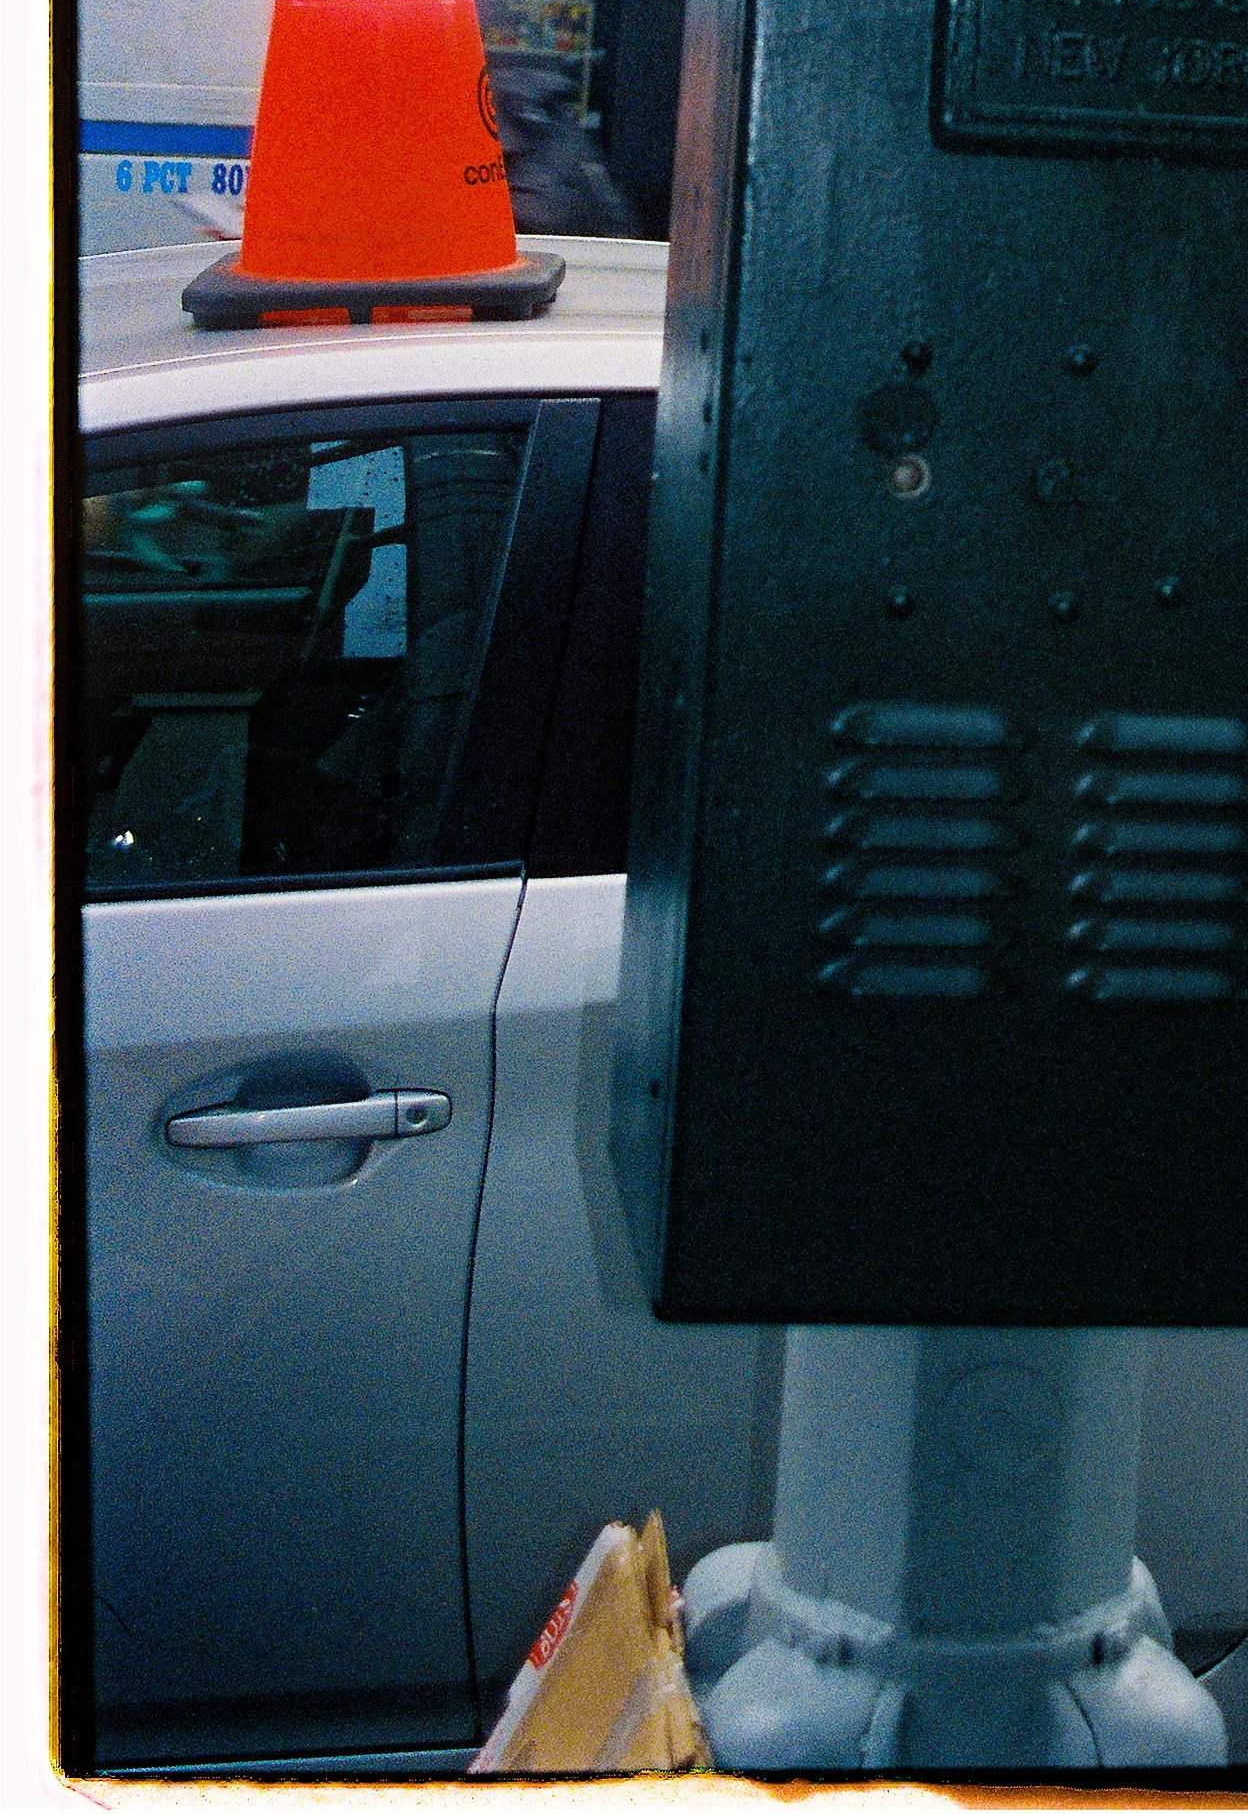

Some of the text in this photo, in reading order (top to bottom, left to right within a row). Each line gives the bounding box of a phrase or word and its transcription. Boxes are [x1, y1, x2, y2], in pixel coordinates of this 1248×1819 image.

[1011, 28, 1132, 85] NEW
[115, 158, 250, 196] 6 PCT 80
